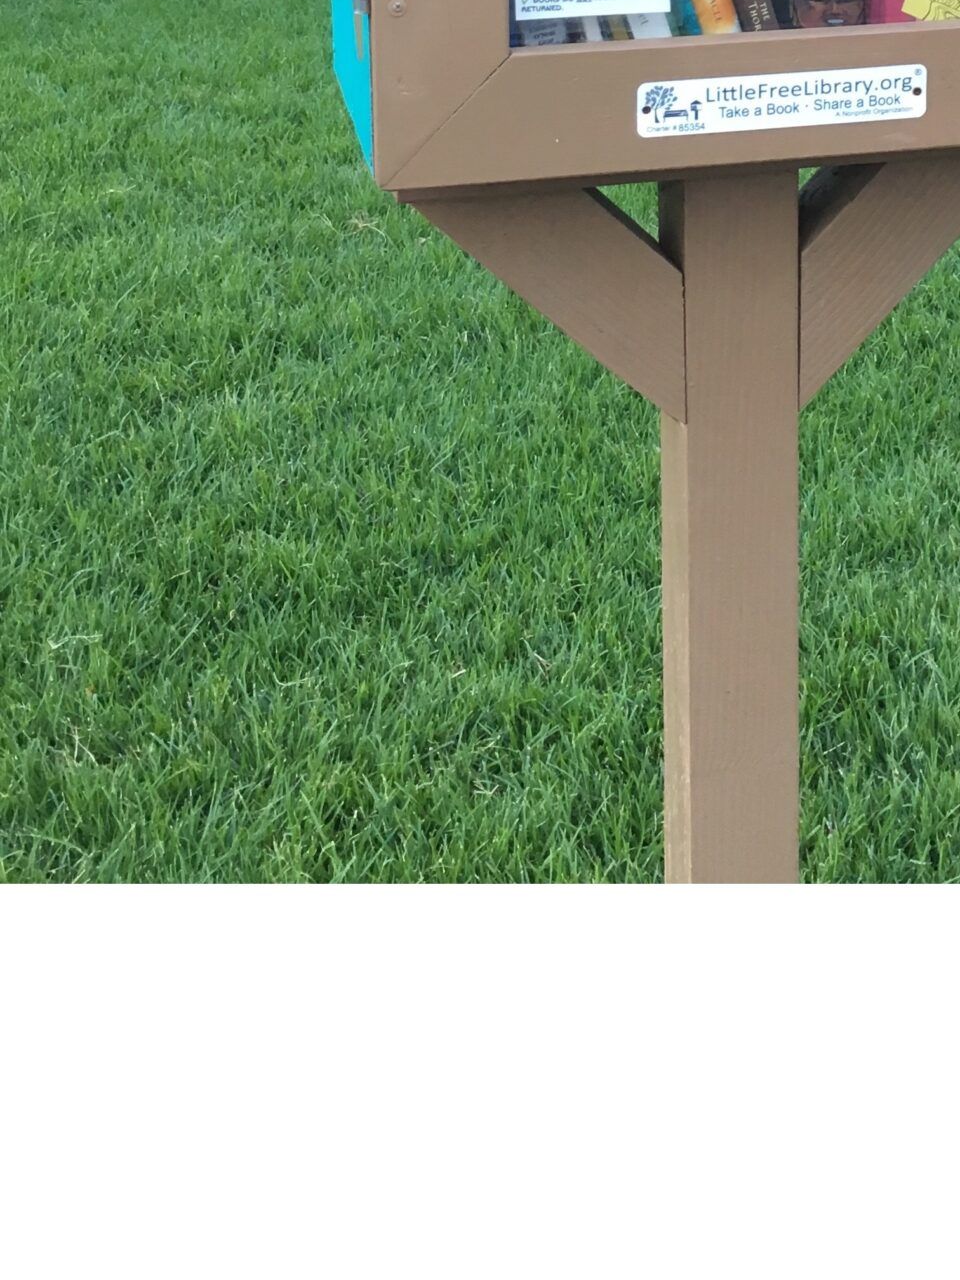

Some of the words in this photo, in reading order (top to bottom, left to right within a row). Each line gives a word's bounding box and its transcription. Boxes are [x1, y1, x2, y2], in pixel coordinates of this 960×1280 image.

[748, 2, 762, 32] THOR
[760, 2, 770, 21] THE
[706, 76, 912, 103] LittleFreeLibrary.org
[718, 106, 750, 119] Take
[754, 107, 762, 116] a
[767, 101, 800, 116] Book
[814, 98, 852, 111] Share
[856, 98, 864, 108] a
[868, 93, 901, 107] Book
[678, 122, 705, 132] 85354
